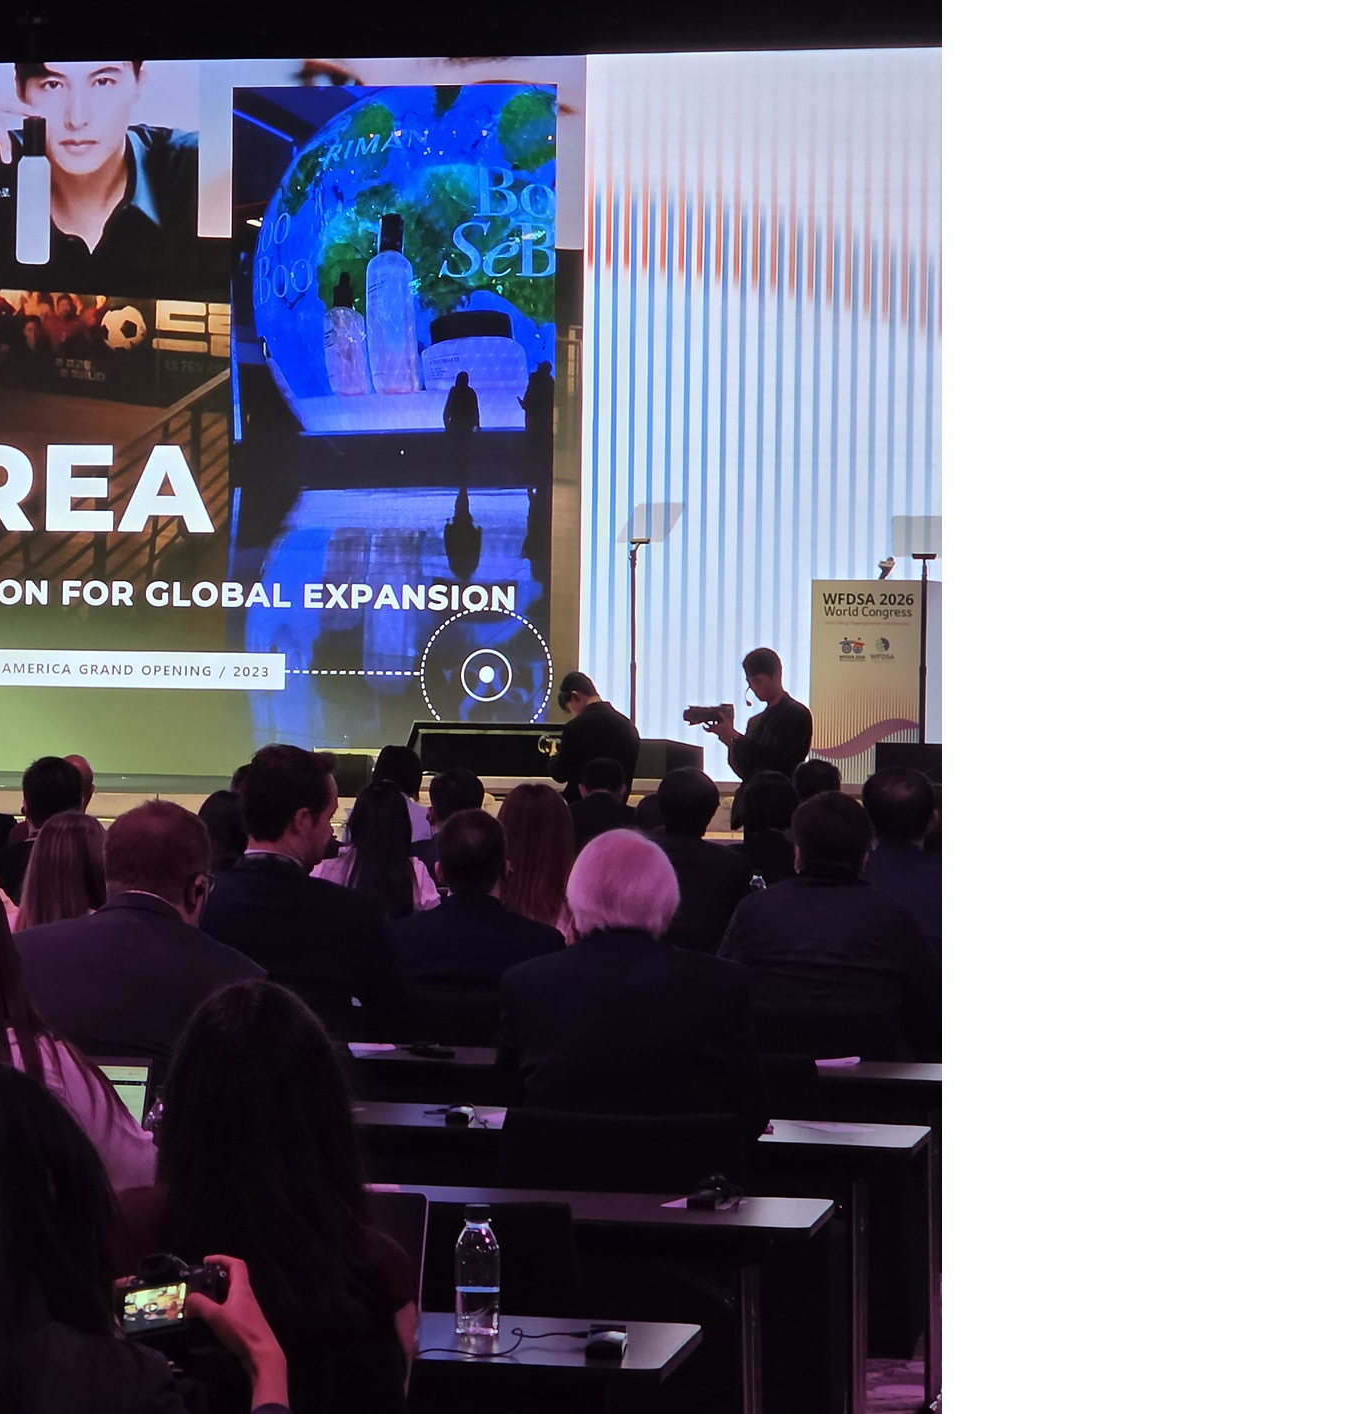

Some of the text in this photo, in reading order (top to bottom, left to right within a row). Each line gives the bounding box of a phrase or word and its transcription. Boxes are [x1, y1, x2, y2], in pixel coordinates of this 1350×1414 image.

[62, 580, 134, 607] FOR
[145, 581, 291, 609] GLOBAL
[303, 583, 516, 613] EXPANSION
[822, 593, 914, 606] WFDSA 2026
[824, 606, 913, 620] World Congress
[2, 662, 72, 676] AMERICA
[79, 664, 134, 677] GRAND
[141, 665, 213, 678] OPENING
[218, 665, 227, 680] /
[232, 666, 270, 679] 2023
